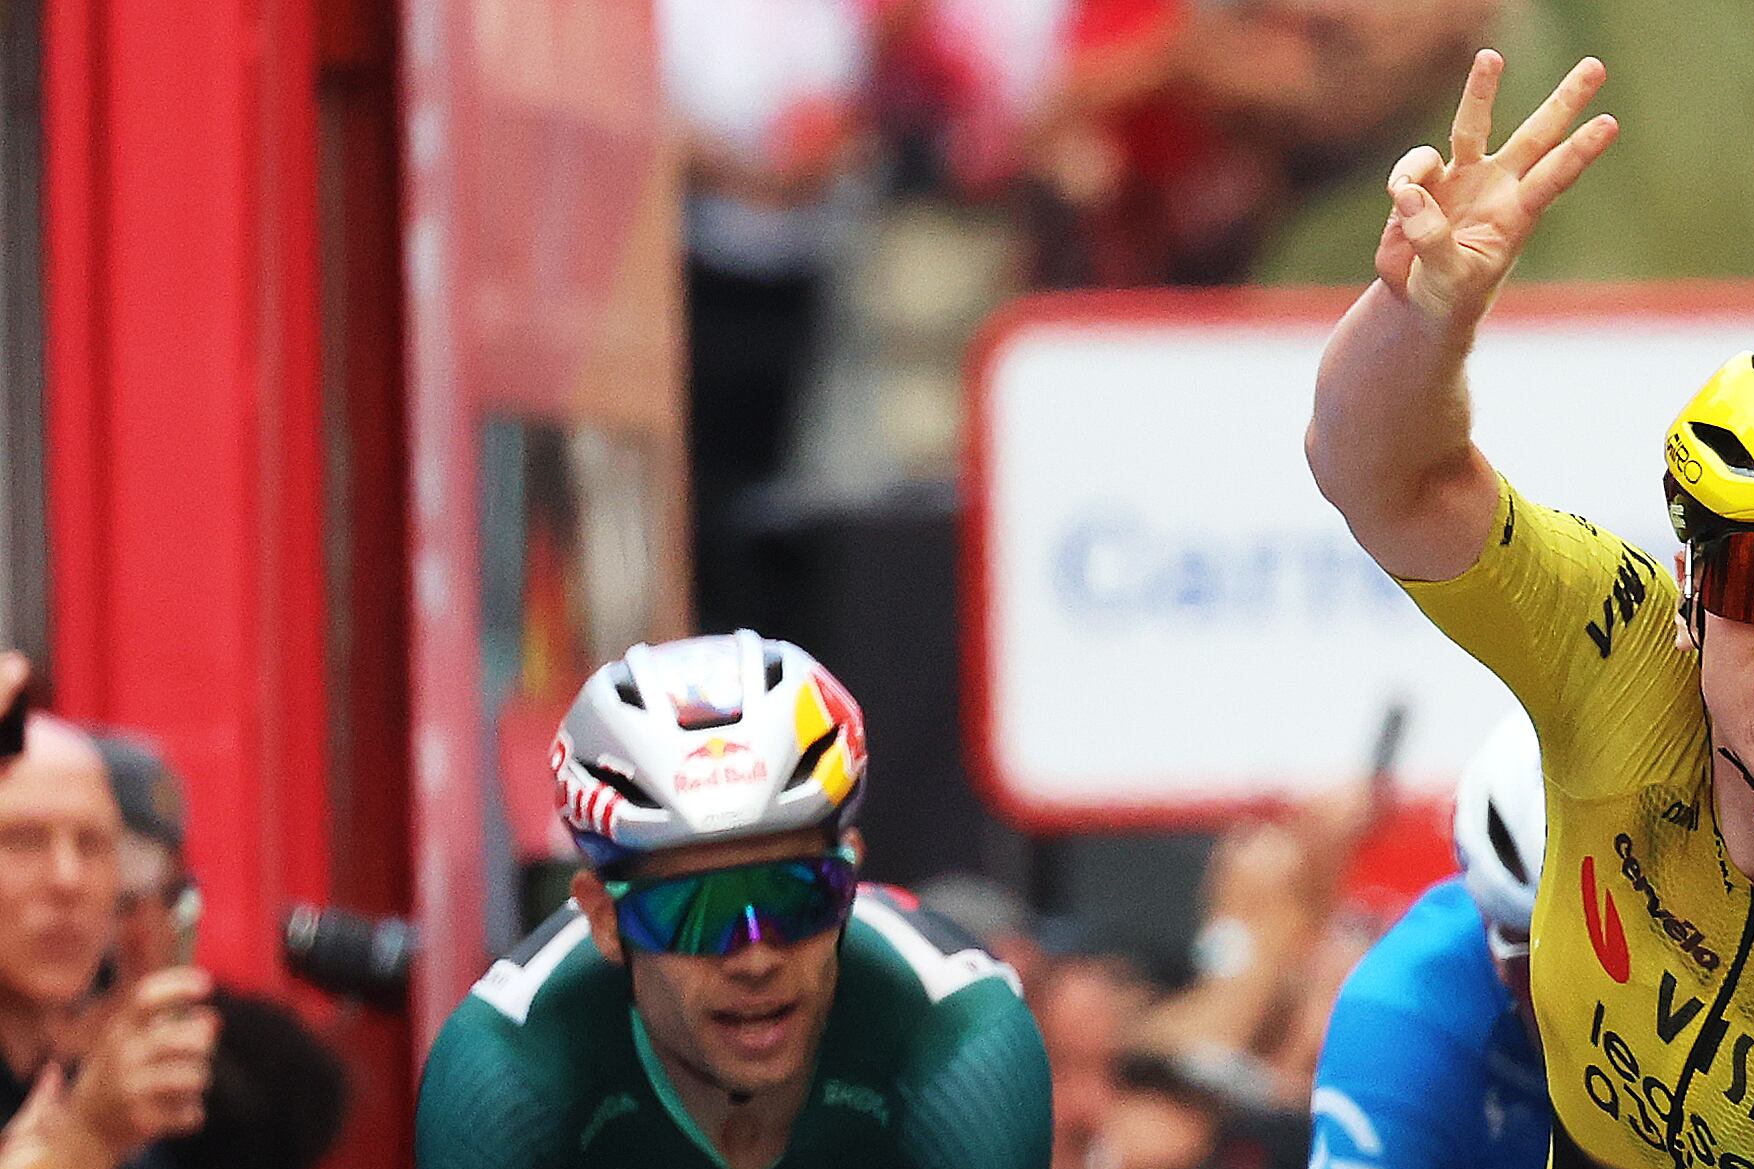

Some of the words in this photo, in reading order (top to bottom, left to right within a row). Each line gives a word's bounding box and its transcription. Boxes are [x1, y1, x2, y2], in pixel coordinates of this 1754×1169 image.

[1666, 434, 1703, 484] GIRO
[673, 770, 720, 796] Red
[724, 760, 768, 786] Bull
